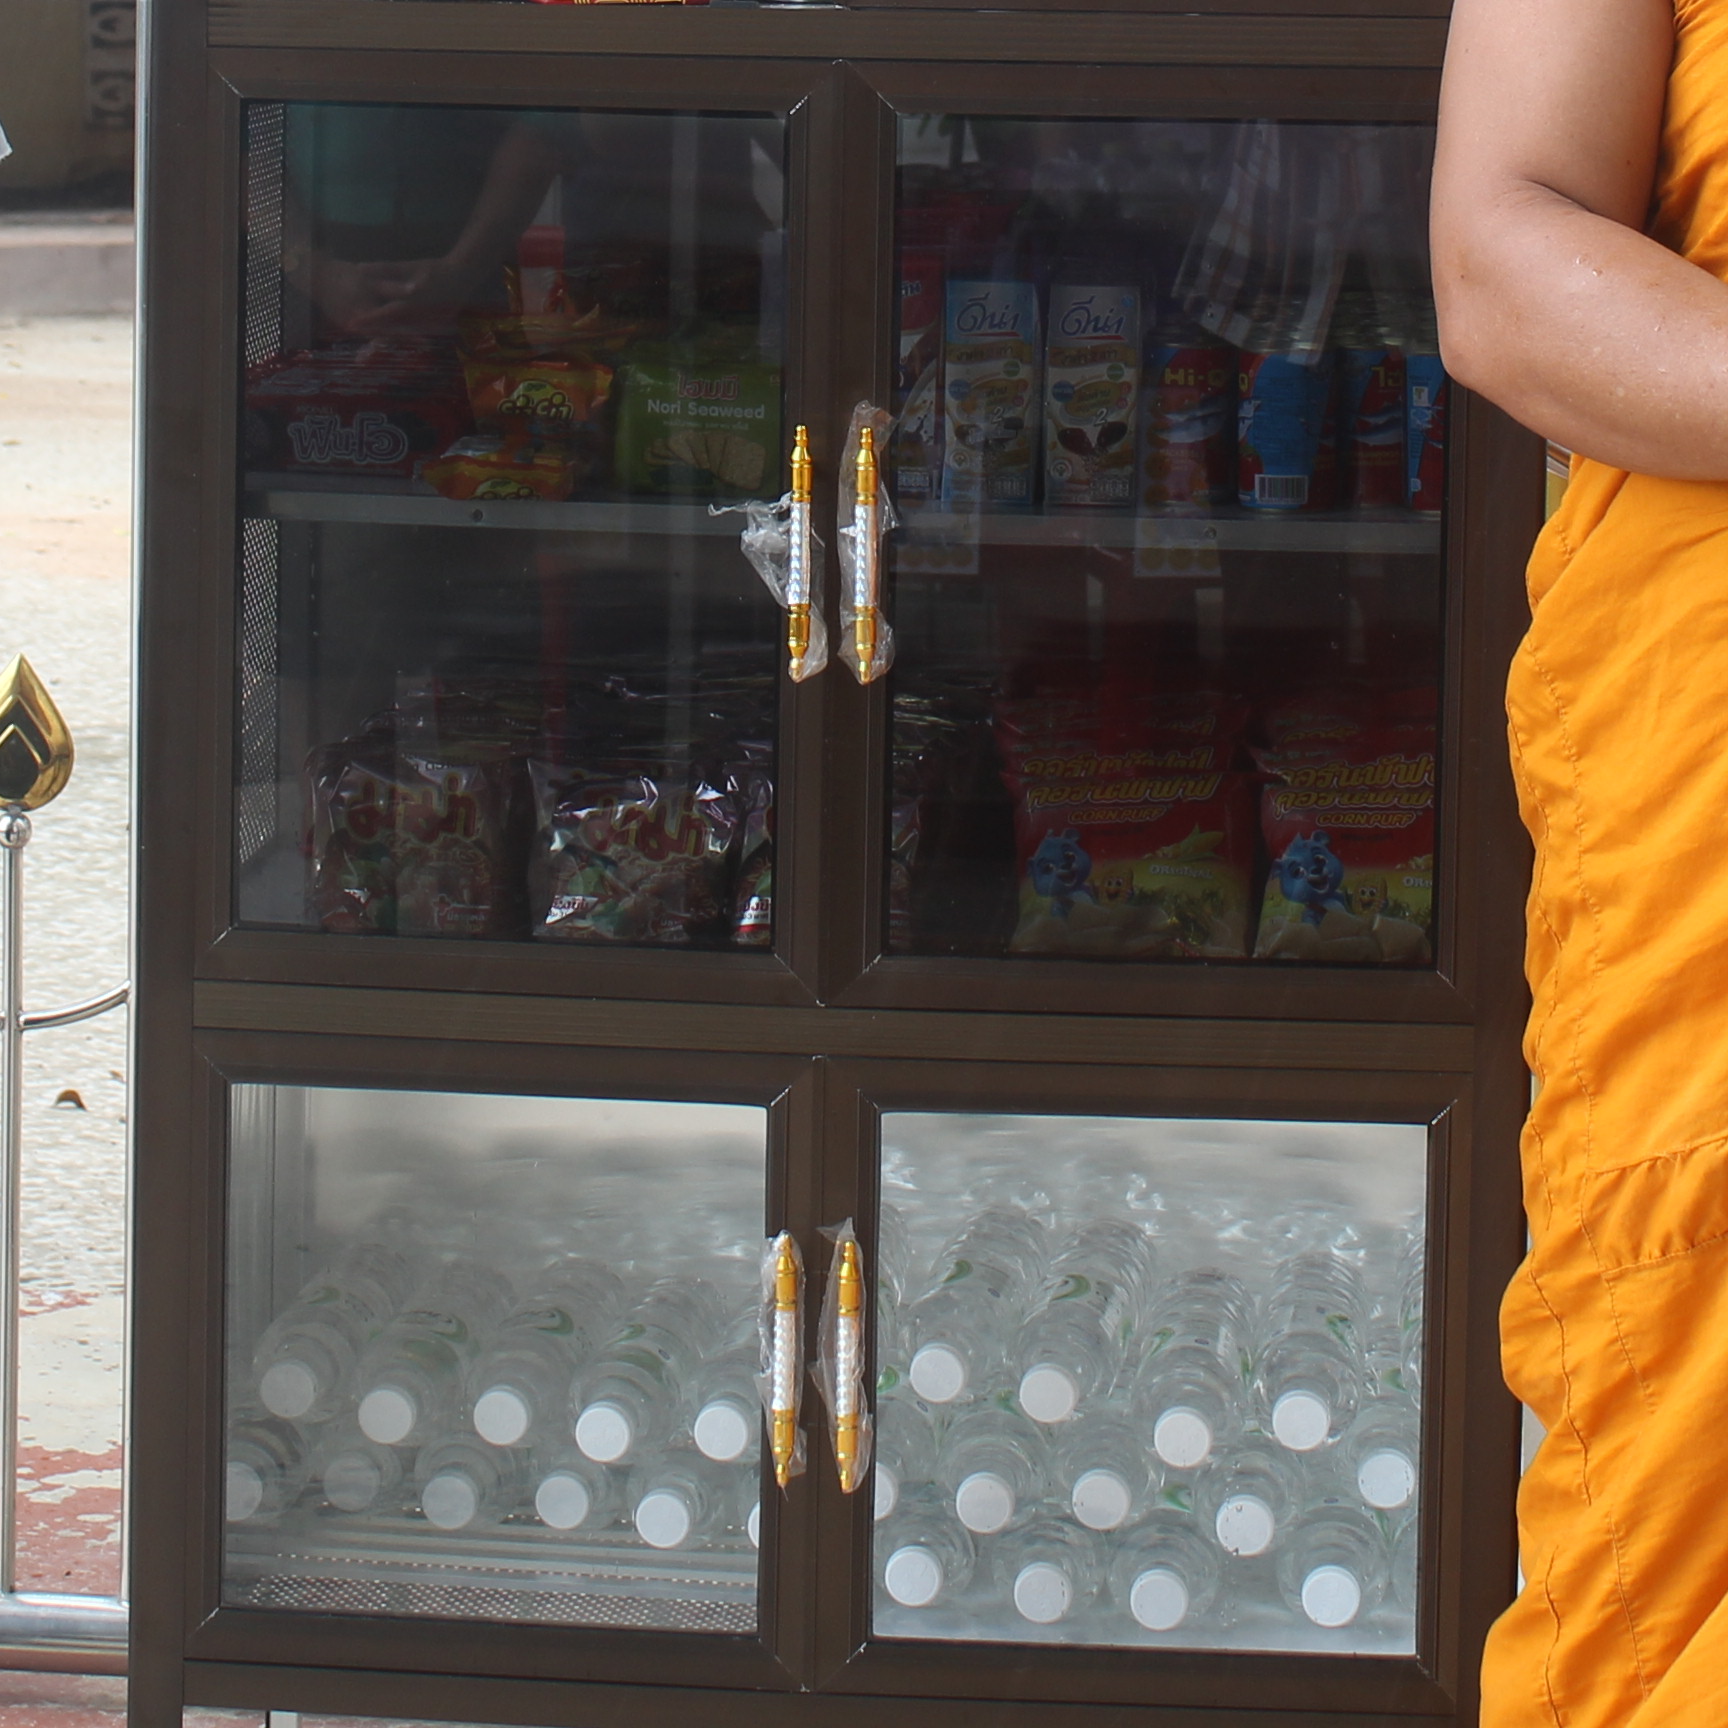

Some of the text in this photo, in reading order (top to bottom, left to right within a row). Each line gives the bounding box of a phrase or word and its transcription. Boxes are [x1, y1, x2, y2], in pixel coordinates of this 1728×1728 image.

[647, 399, 765, 419] Nori Seaweed
[1071, 807, 1164, 822] CORN PUFF
[1319, 812, 1413, 826] CORN PUFF
